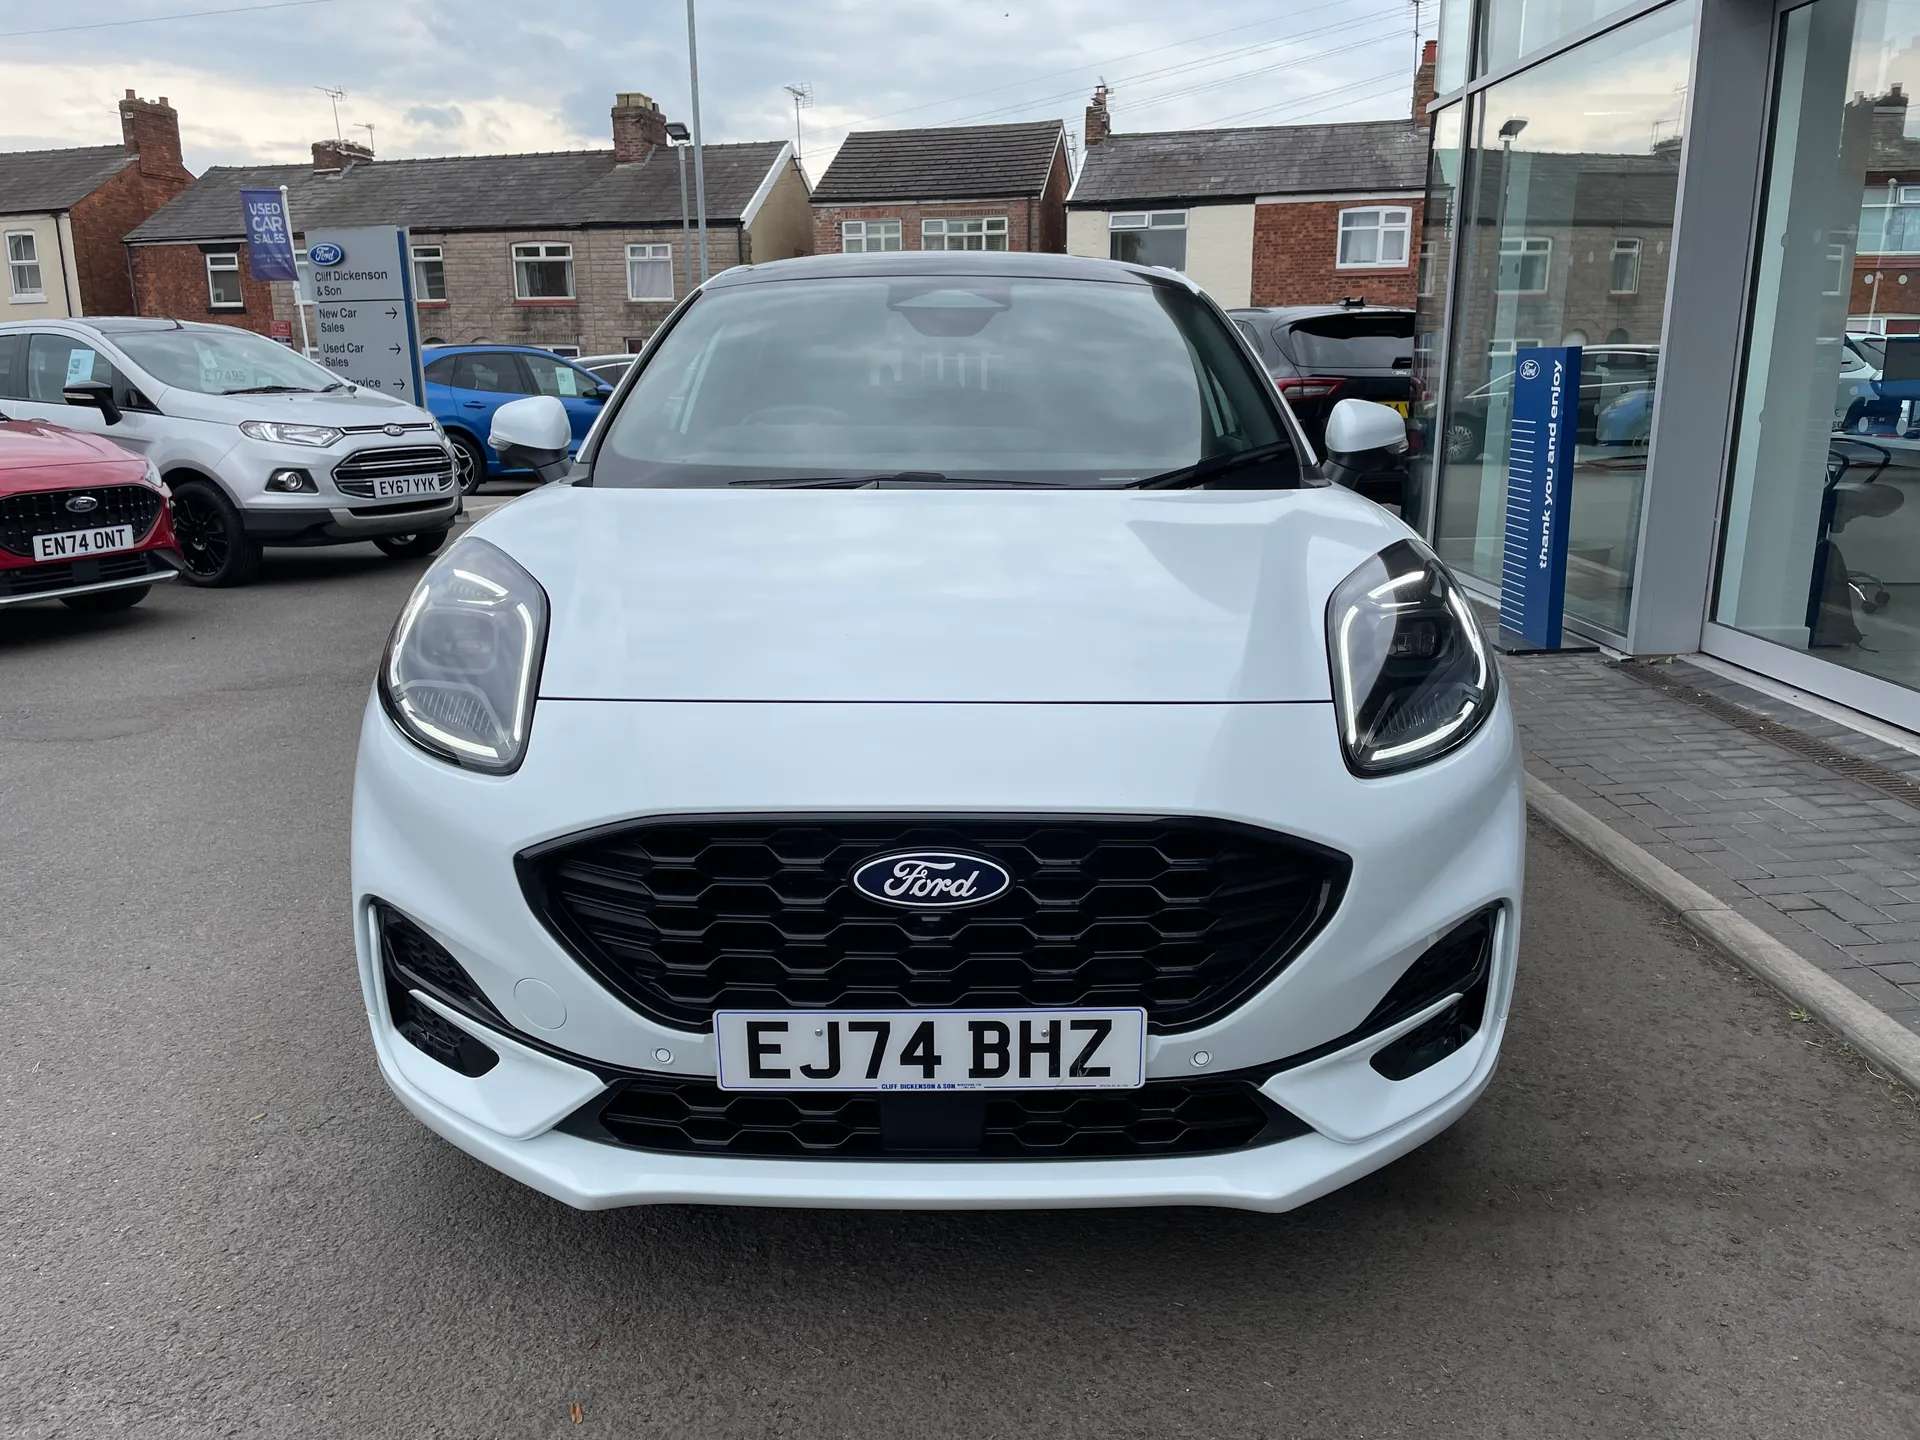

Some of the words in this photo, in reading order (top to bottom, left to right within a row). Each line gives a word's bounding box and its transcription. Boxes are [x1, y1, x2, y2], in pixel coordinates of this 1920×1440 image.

[249, 202, 280, 215] USED
[252, 216, 283, 232] CAR
[254, 233, 286, 244] SALES
[315, 271, 332, 282] Cliff
[333, 270, 388, 281] Dickenson
[317, 286, 323, 297] &
[324, 285, 342, 296] Son
[319, 308, 338, 319] New
[340, 307, 357, 318] Car
[321, 322, 345, 333] Sales
[323, 343, 345, 353] Used
[347, 342, 365, 353] Car
[325, 356, 349, 367] Sales
[1550, 360, 1562, 419] enjoy
[1547, 422, 1557, 464] and
[380, 479, 410, 496] EY67
[413, 477, 436, 493] YYK
[1544, 467, 1553, 506] you
[41, 533, 89, 557] EN74
[94, 528, 125, 549] ONT
[1539, 509, 1551, 569] thank
[884, 860, 980, 898] Ford
[746, 1020, 942, 1080] EJ74
[968, 1019, 1113, 1079] BHZ
